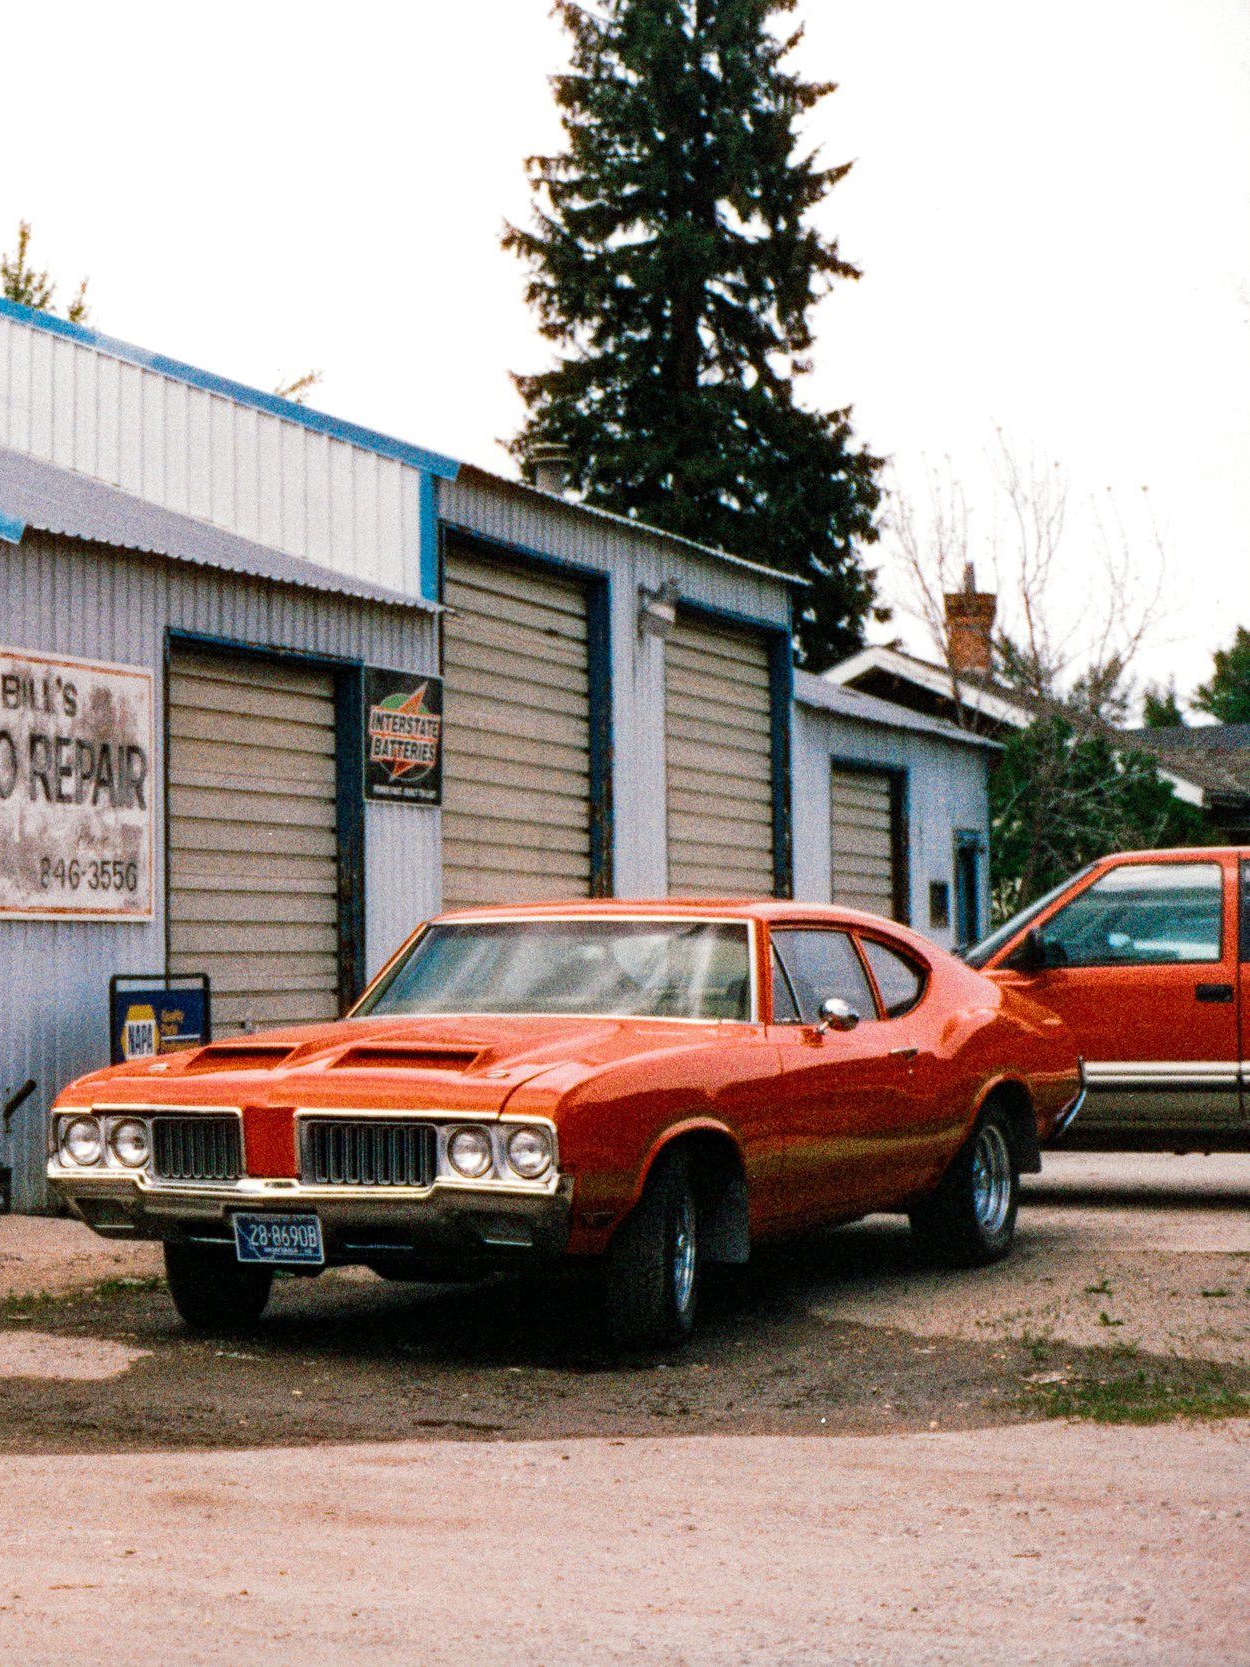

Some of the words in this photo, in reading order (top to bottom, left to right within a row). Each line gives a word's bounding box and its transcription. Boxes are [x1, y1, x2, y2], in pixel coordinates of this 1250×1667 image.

[372, 711, 439, 738] INTERSTATE
[374, 739, 435, 762] BATTERIES
[28, 733, 148, 811] REPAIR
[39, 856, 139, 892] 846-3556
[127, 1023, 153, 1055] NAPA
[249, 1224, 318, 1248] 28-8690B
